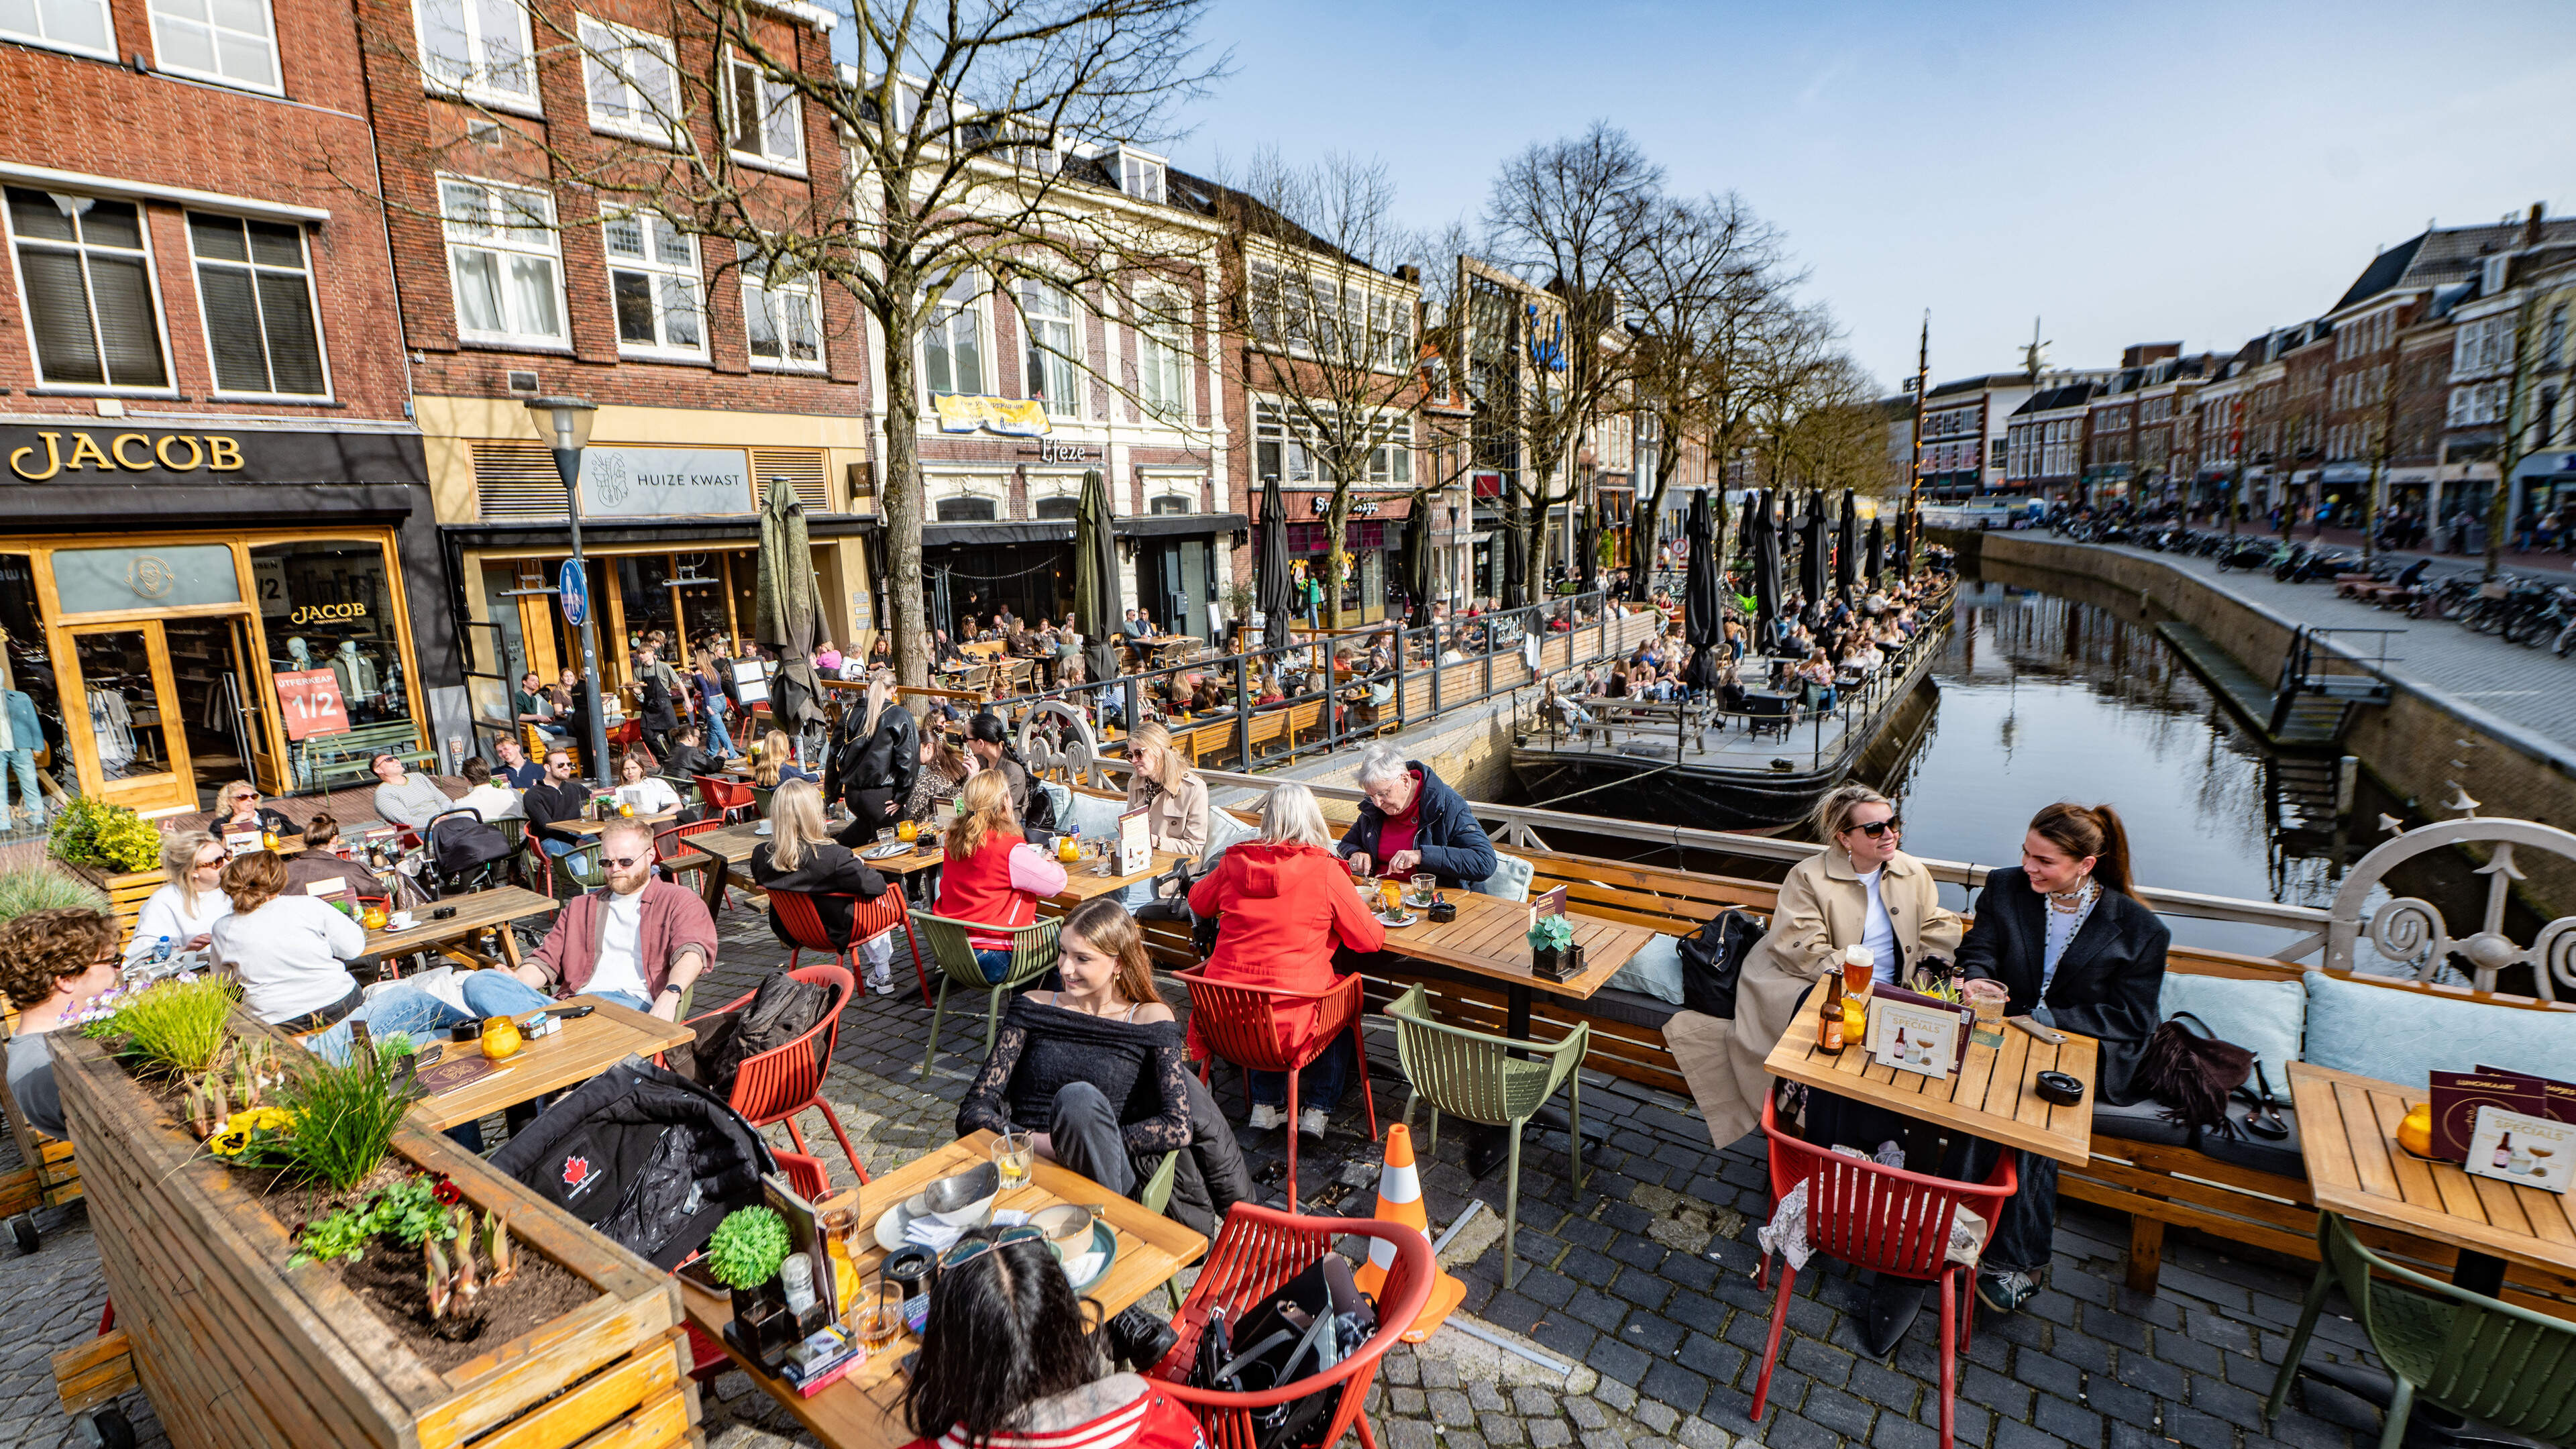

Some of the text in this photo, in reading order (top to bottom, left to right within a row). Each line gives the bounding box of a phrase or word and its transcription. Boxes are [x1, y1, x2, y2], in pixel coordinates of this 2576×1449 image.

[9, 431, 246, 480] JACOB
[1041, 438, 1085, 465] Efeze
[637, 474, 740, 486] HUIZE KWAST
[290, 602, 368, 625] JACOB
[292, 692, 337, 720] 1/2
[1892, 1017, 1940, 1034] SPECIALS
[2493, 1120, 2565, 1141] SPECIALS
